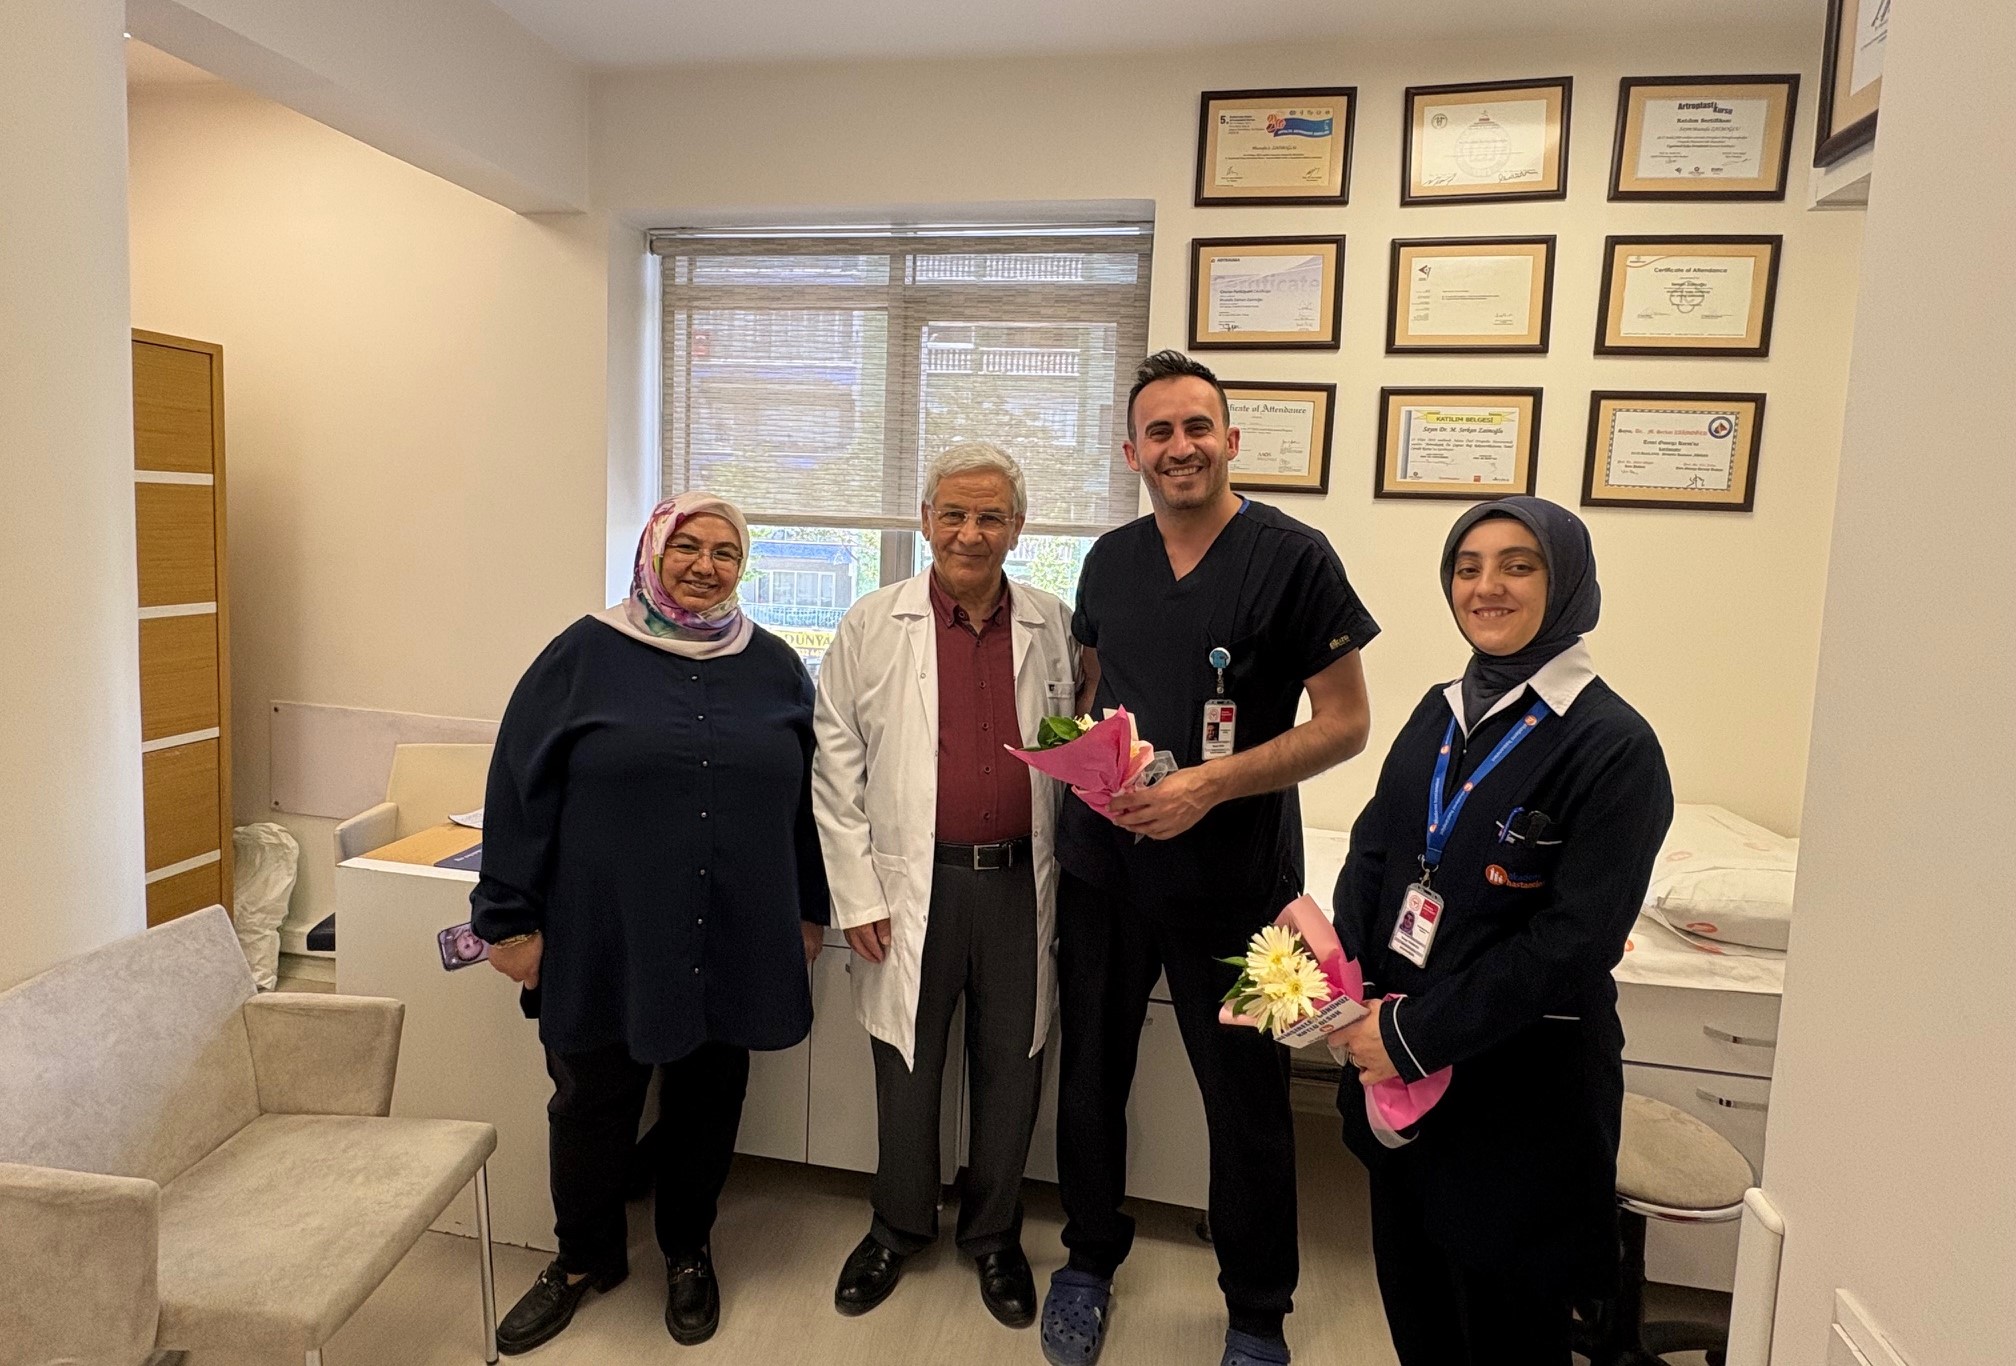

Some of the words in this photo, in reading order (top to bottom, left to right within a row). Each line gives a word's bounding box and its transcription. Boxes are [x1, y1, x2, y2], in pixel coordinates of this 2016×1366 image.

[1220, 115, 1229, 125] 5.
[1251, 404, 1260, 413] of
[1260, 403, 1307, 414] Attendance
